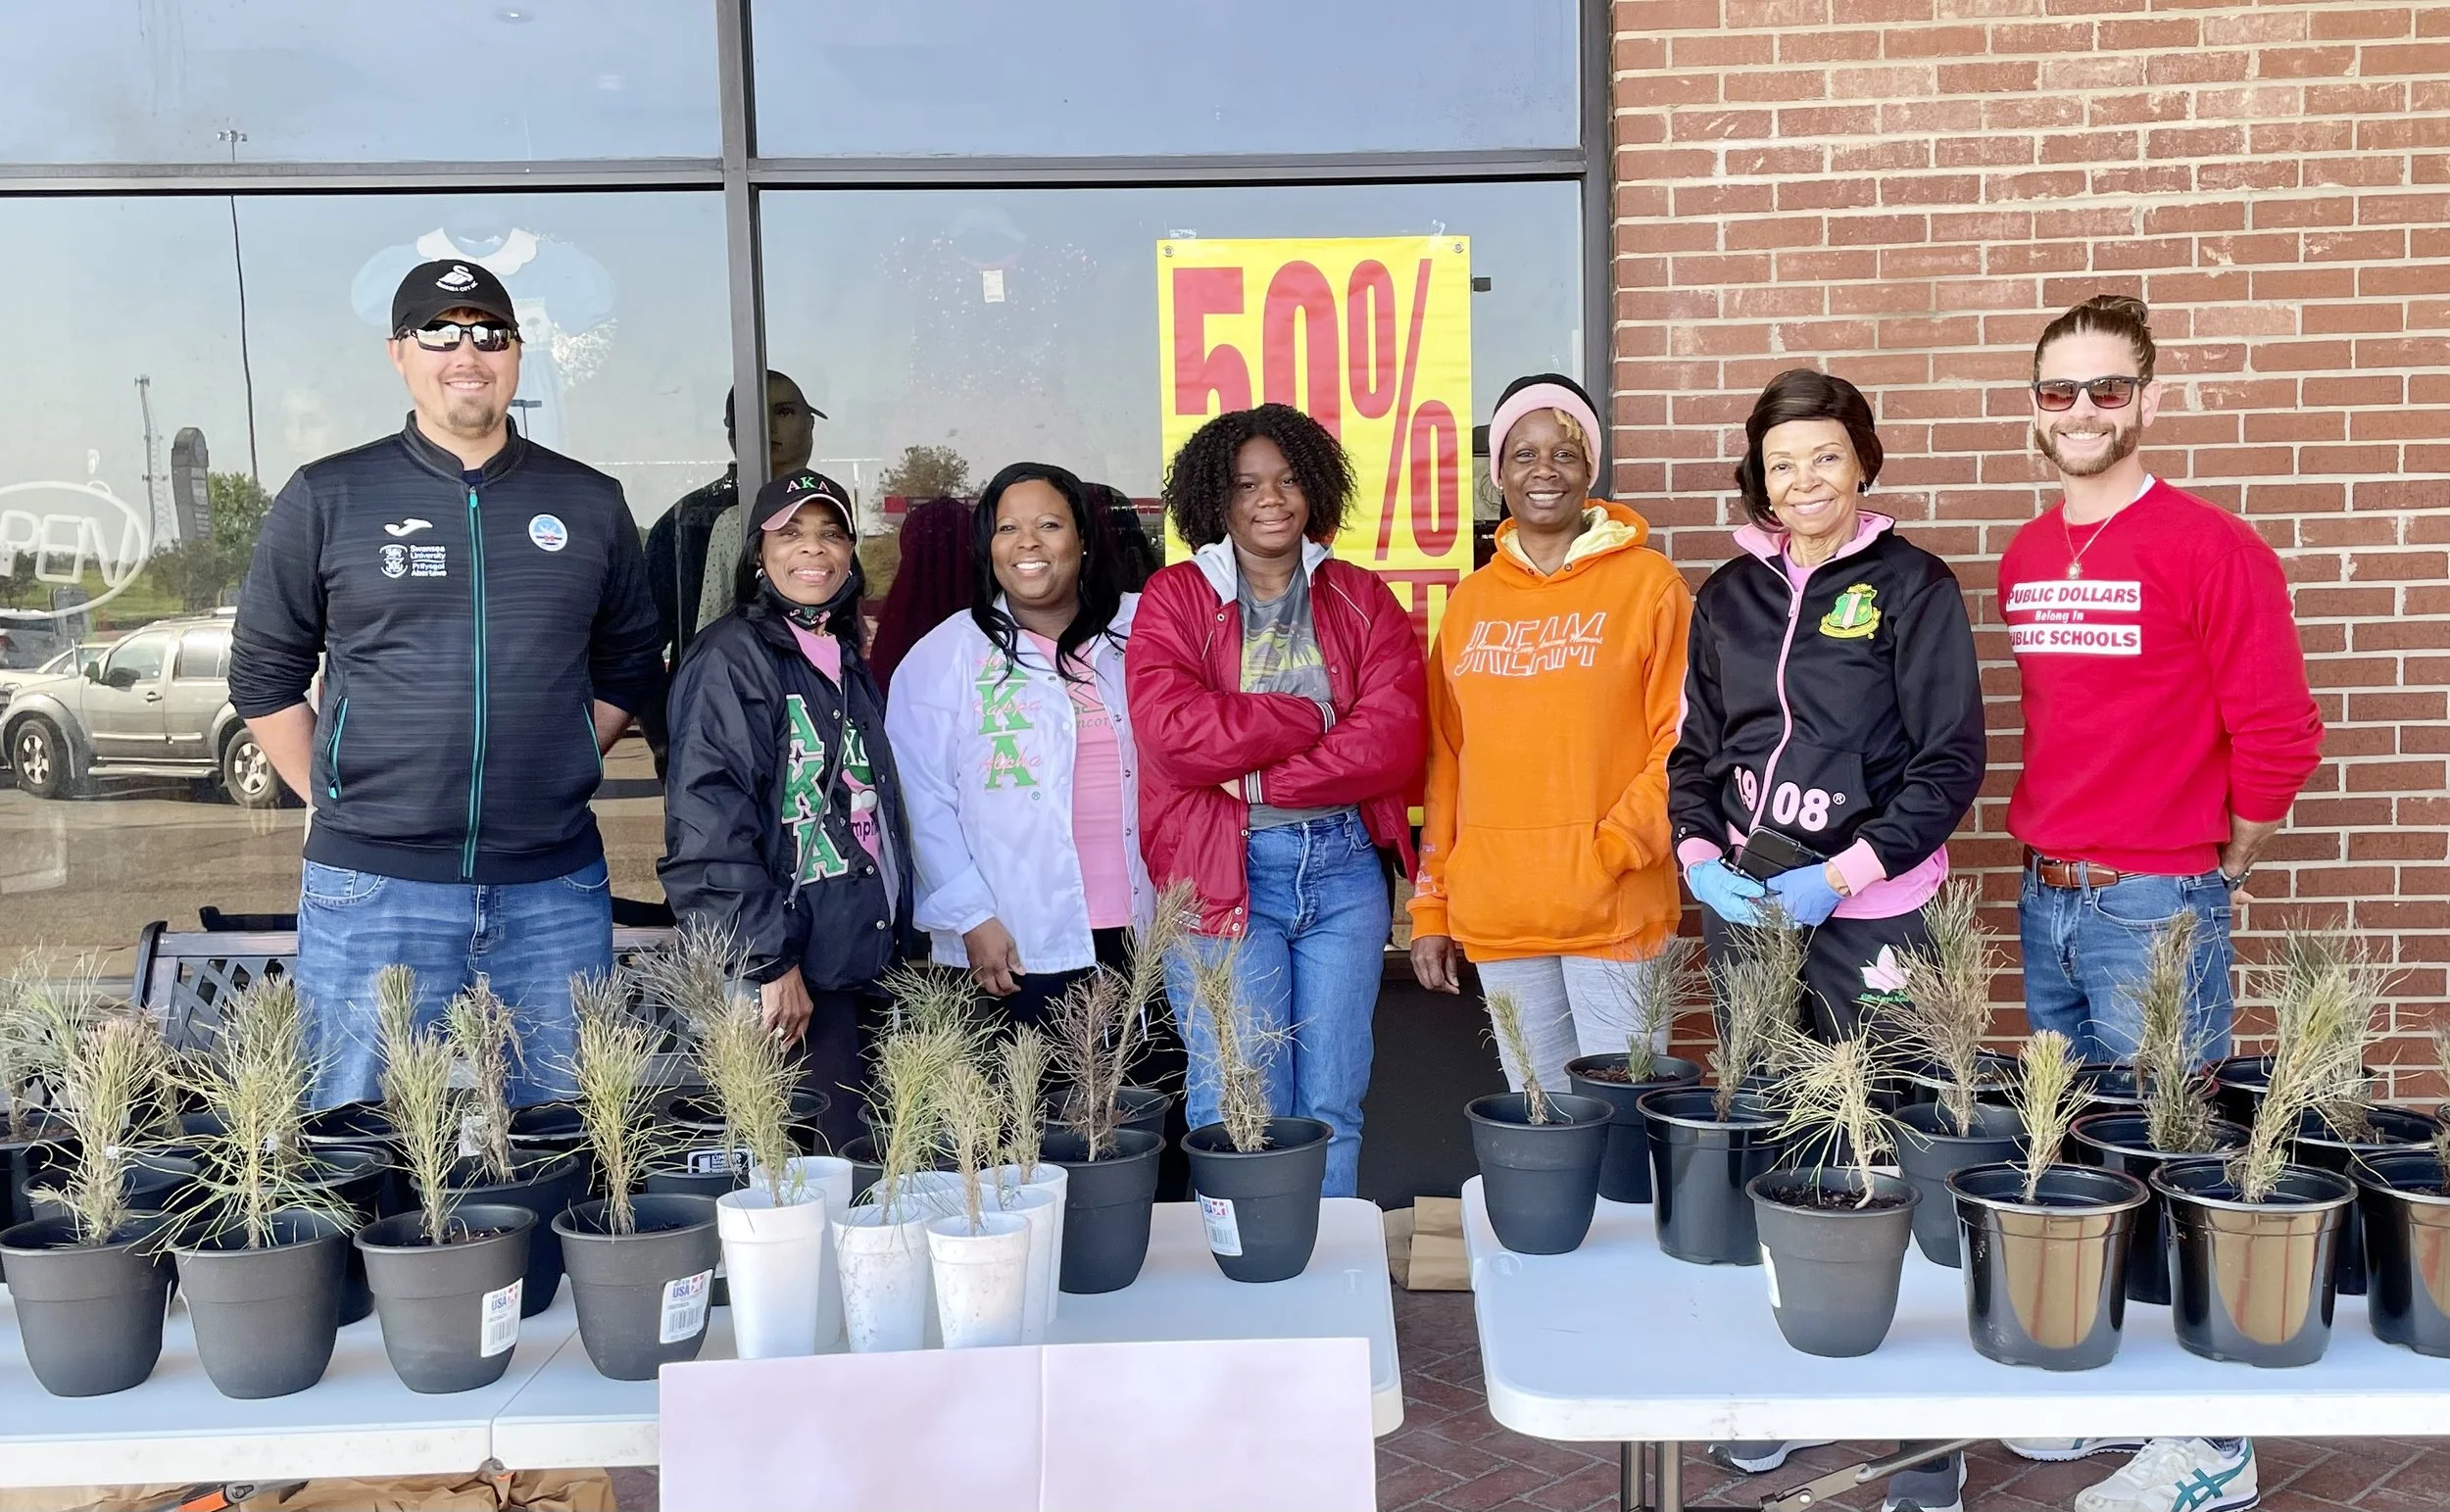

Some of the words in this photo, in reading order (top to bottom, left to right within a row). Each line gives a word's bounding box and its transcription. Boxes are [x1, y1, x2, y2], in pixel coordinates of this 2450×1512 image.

[786, 476, 831, 494] AKA
[2058, 587, 2138, 604] DOLLARS
[2034, 610, 2070, 624] Belong
[2050, 630, 2137, 648] SCHOOLS
